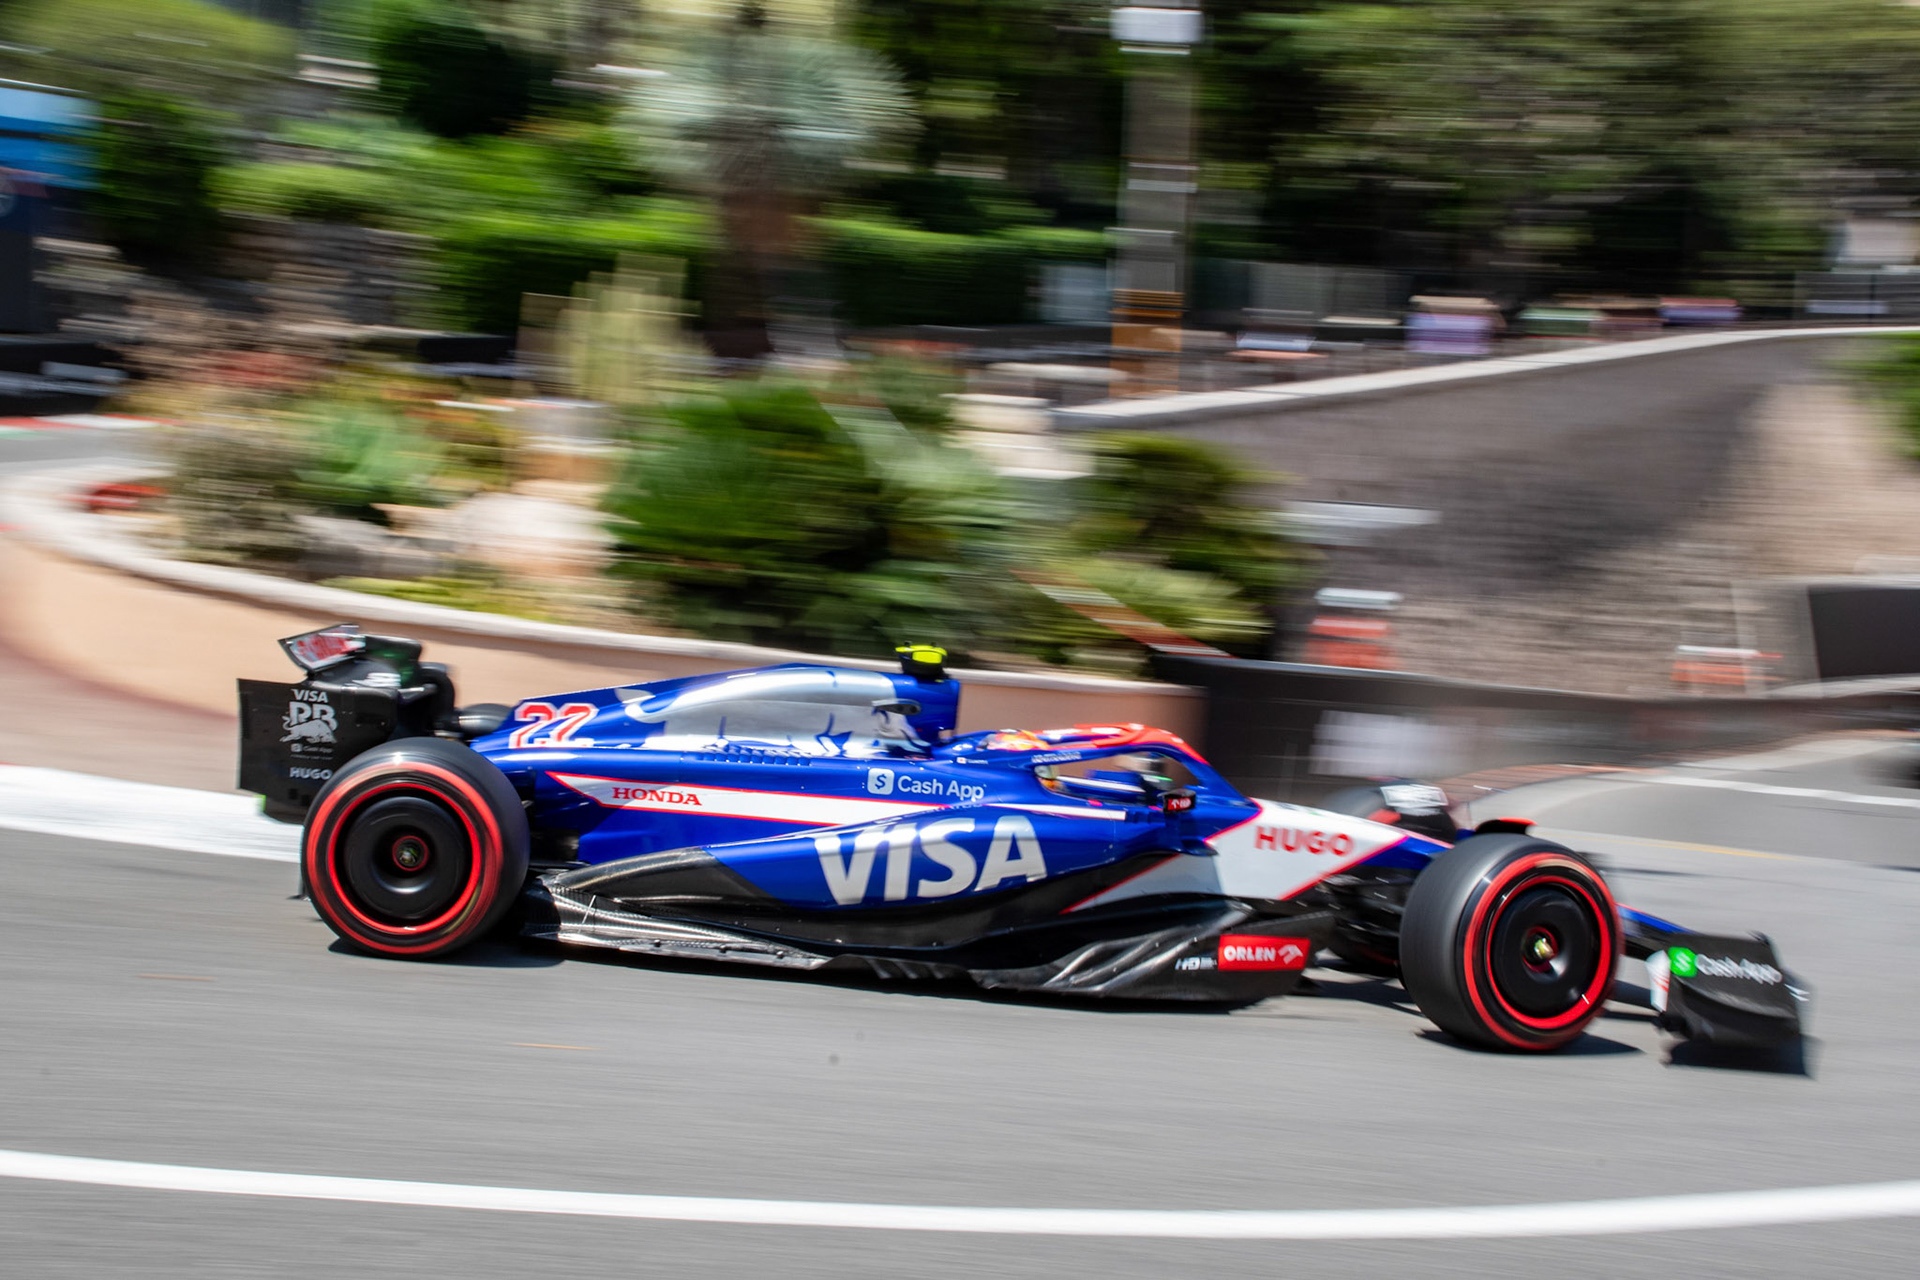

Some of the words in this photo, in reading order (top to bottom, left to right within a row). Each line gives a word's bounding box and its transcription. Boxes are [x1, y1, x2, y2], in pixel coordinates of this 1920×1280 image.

[290, 689, 329, 703] VISA
[508, 702, 599, 749] 22
[289, 766, 333, 780] HUGO
[611, 787, 702, 806] HONDA
[897, 775, 944, 795] Cash
[946, 780, 985, 802] App
[1254, 826, 1355, 856] HUGO
[813, 815, 1048, 905] VISA
[1223, 945, 1276, 962] ORLEN
